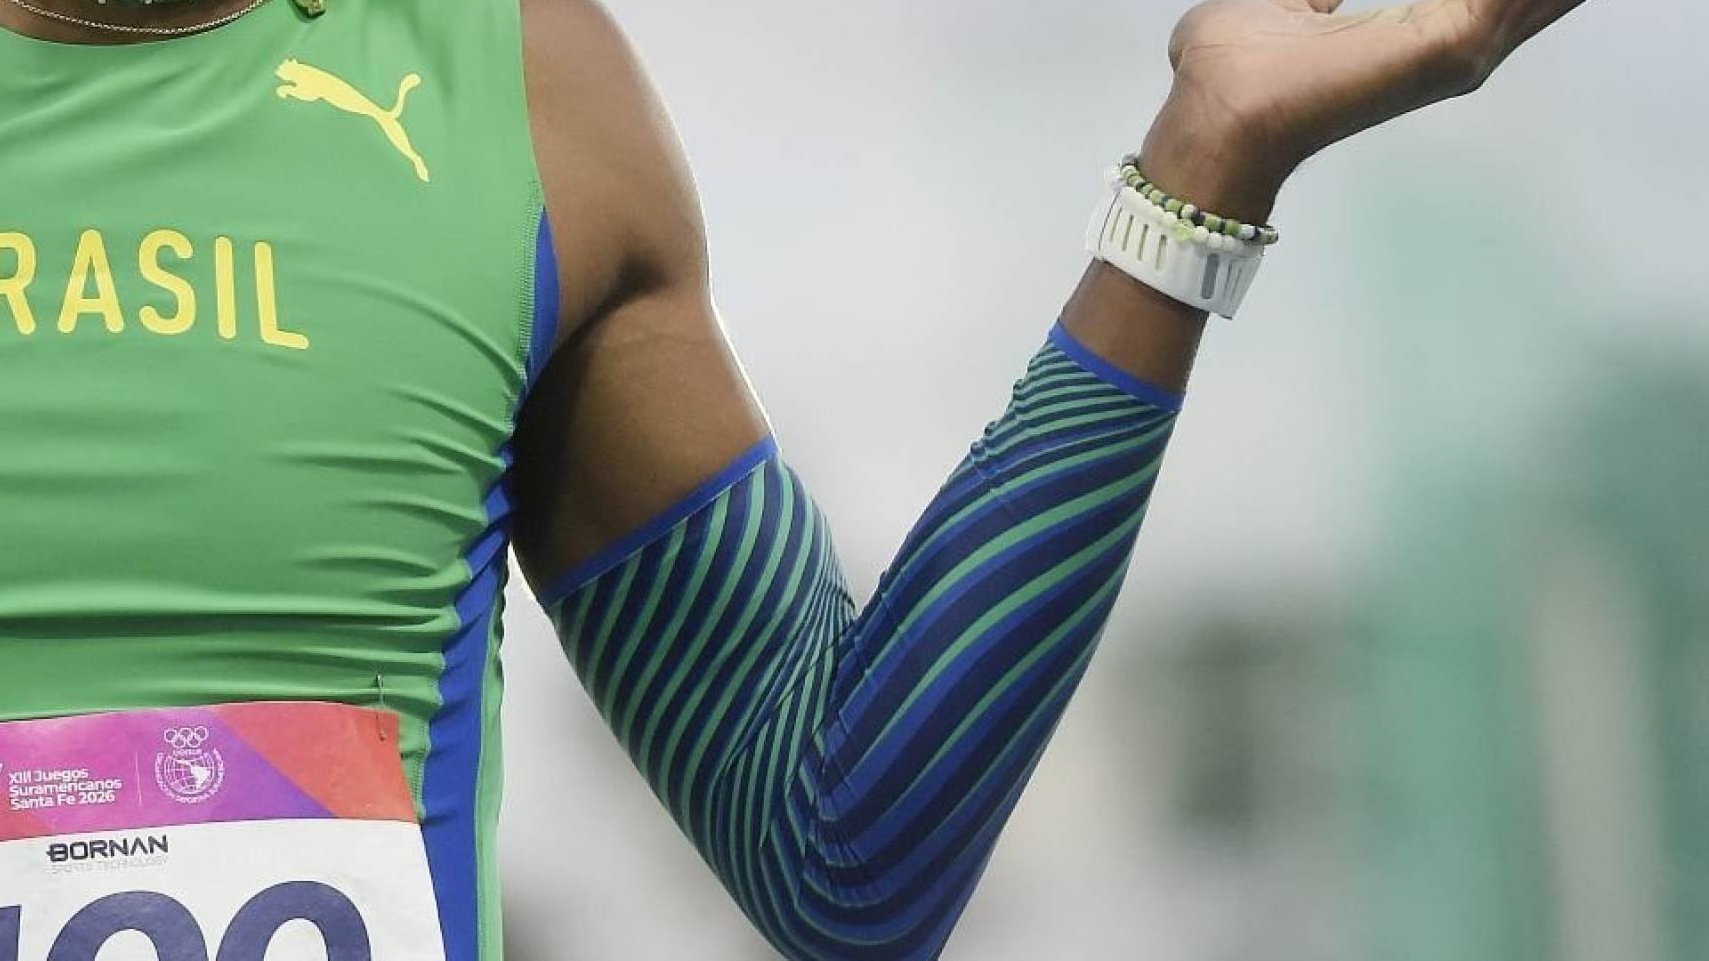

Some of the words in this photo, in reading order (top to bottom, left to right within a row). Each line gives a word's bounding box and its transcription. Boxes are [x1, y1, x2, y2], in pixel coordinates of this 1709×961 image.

[9, 770, 31, 785] XIII
[34, 768, 89, 782] Juegos
[9, 779, 122, 797] Suramericanos
[11, 795, 54, 810] Santa
[57, 793, 76, 806] Fe
[78, 790, 115, 805] 2026
[45, 834, 168, 862] BORNAN
